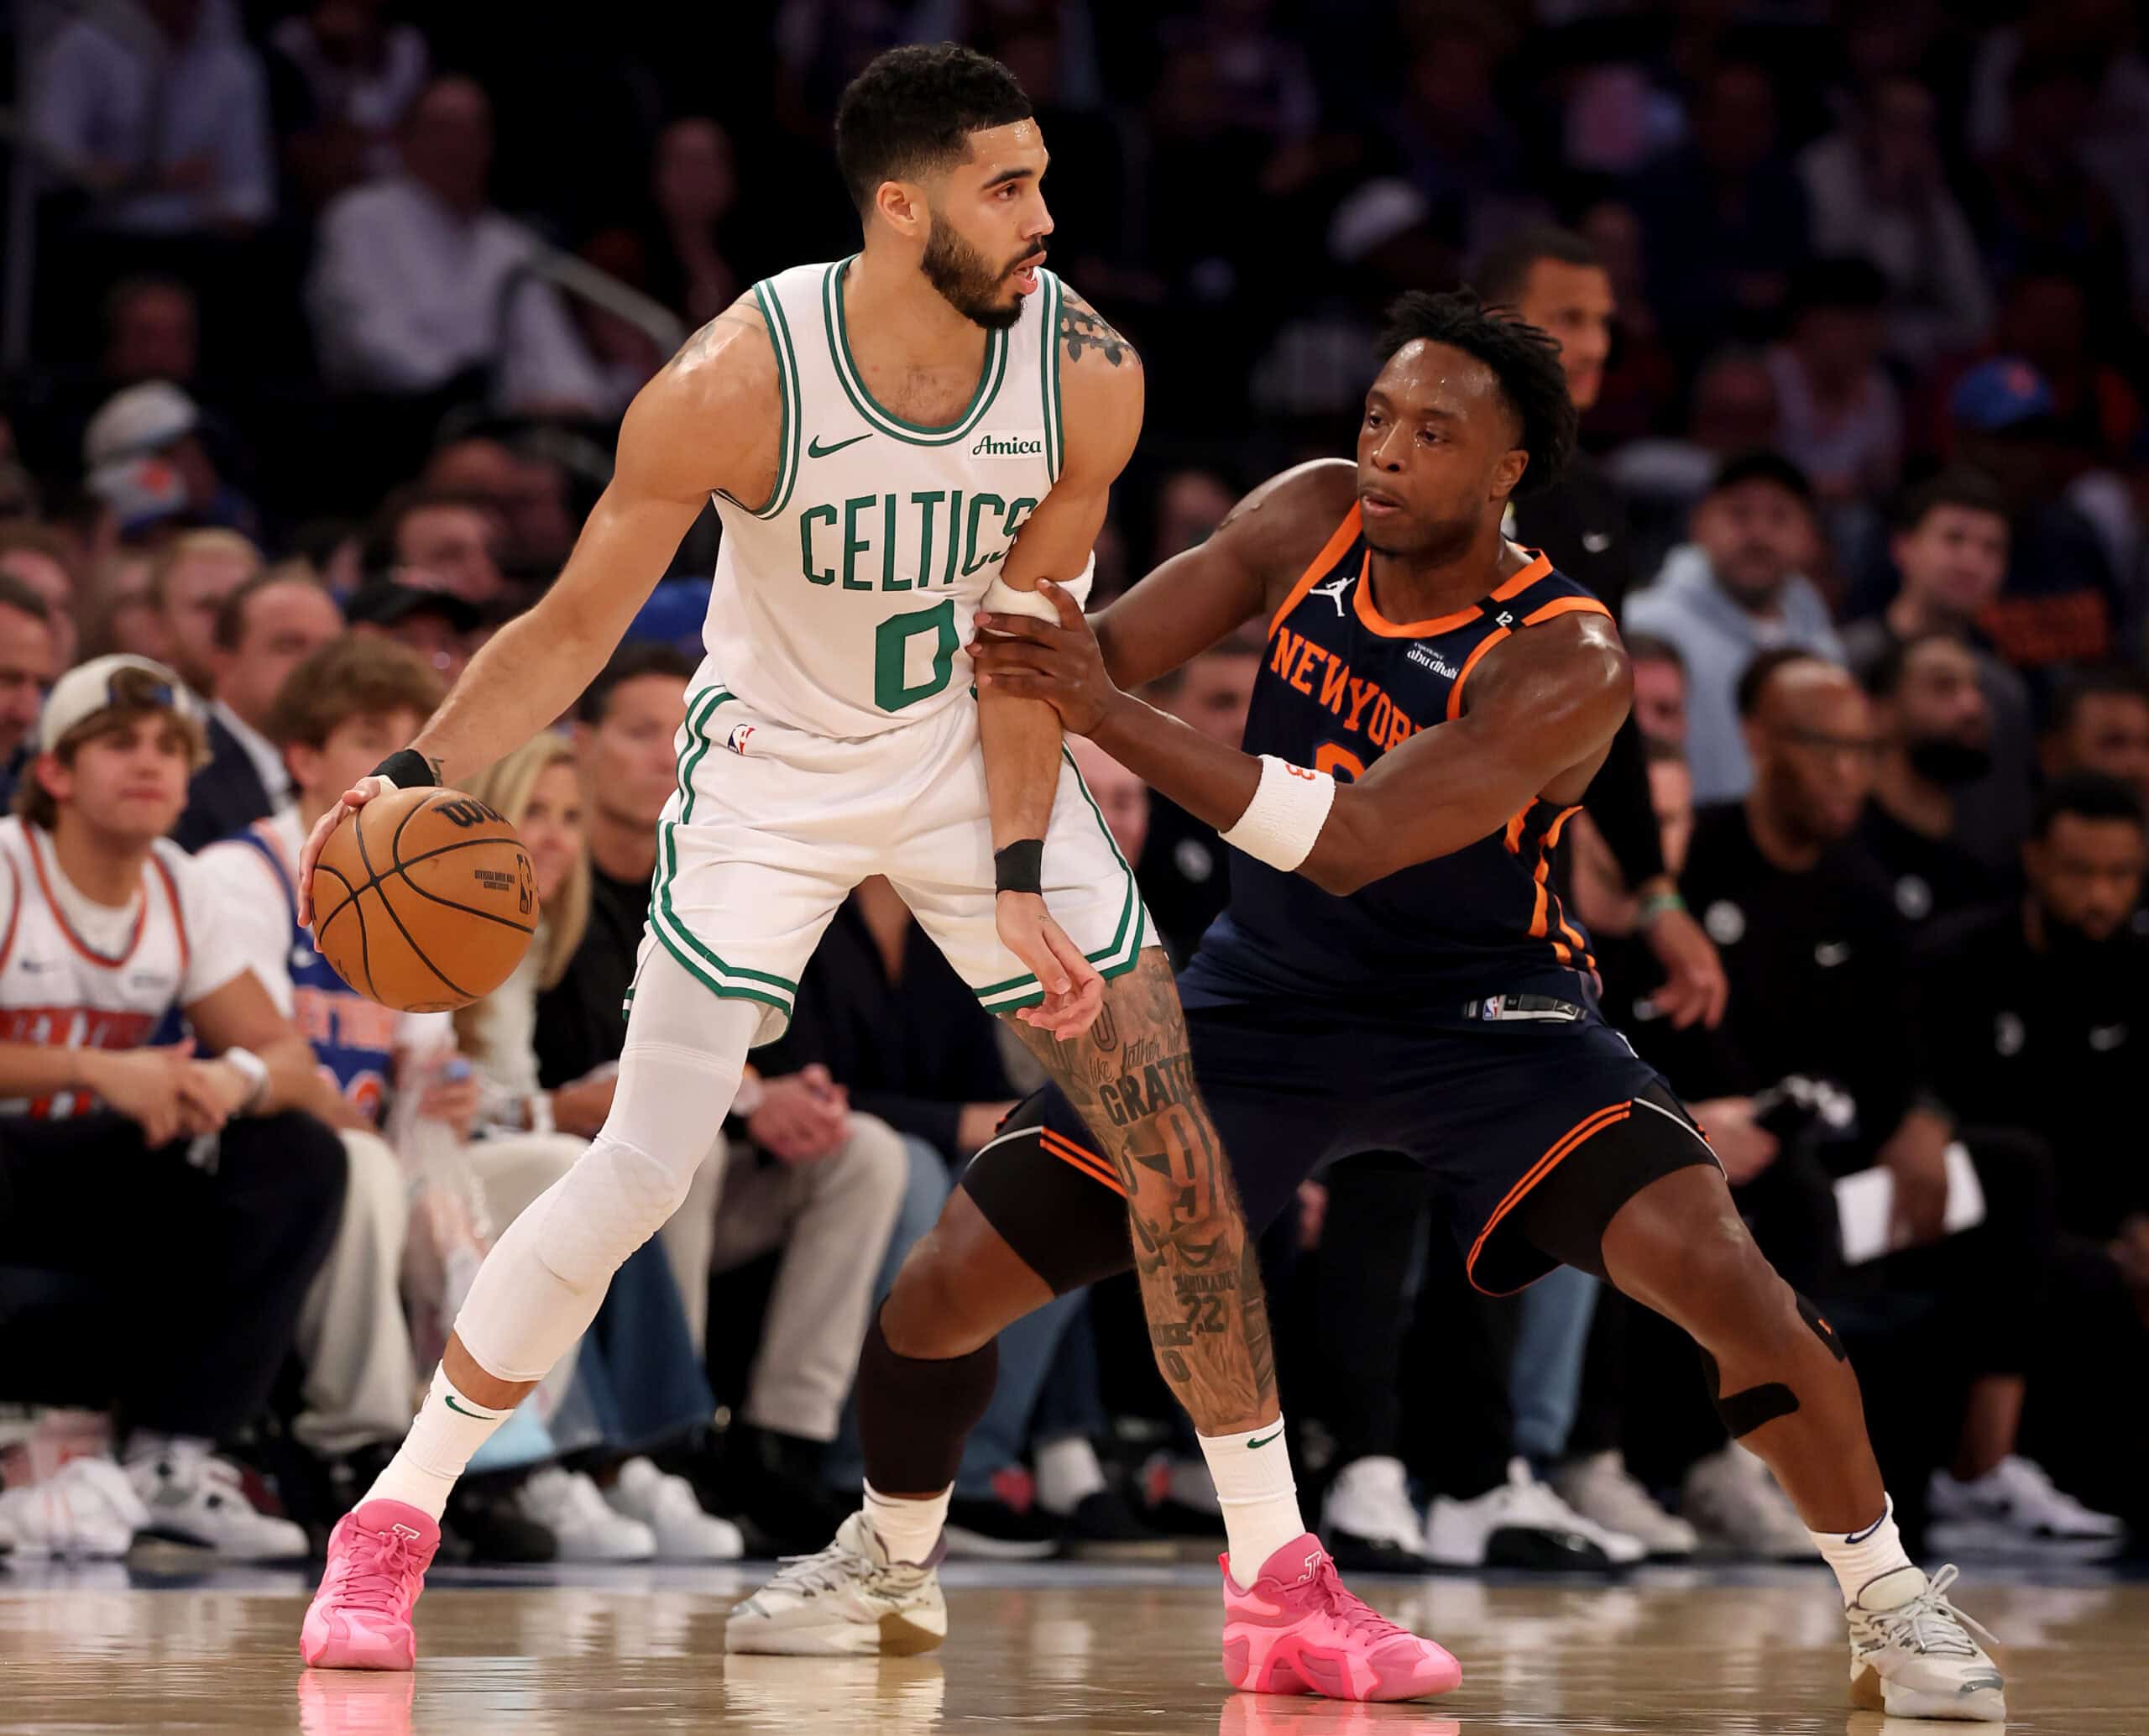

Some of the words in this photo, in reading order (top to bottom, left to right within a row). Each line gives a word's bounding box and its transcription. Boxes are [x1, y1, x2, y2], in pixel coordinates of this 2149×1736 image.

[972, 434, 1042, 456] Amica
[799, 489, 1038, 592] CELTICS
[874, 598, 960, 714] 0
[1270, 626, 1350, 714] NEW
[1342, 677, 1425, 753] YOR
[1179, 1294, 1226, 1333] 22
[1161, 1349, 1191, 1382] 0
